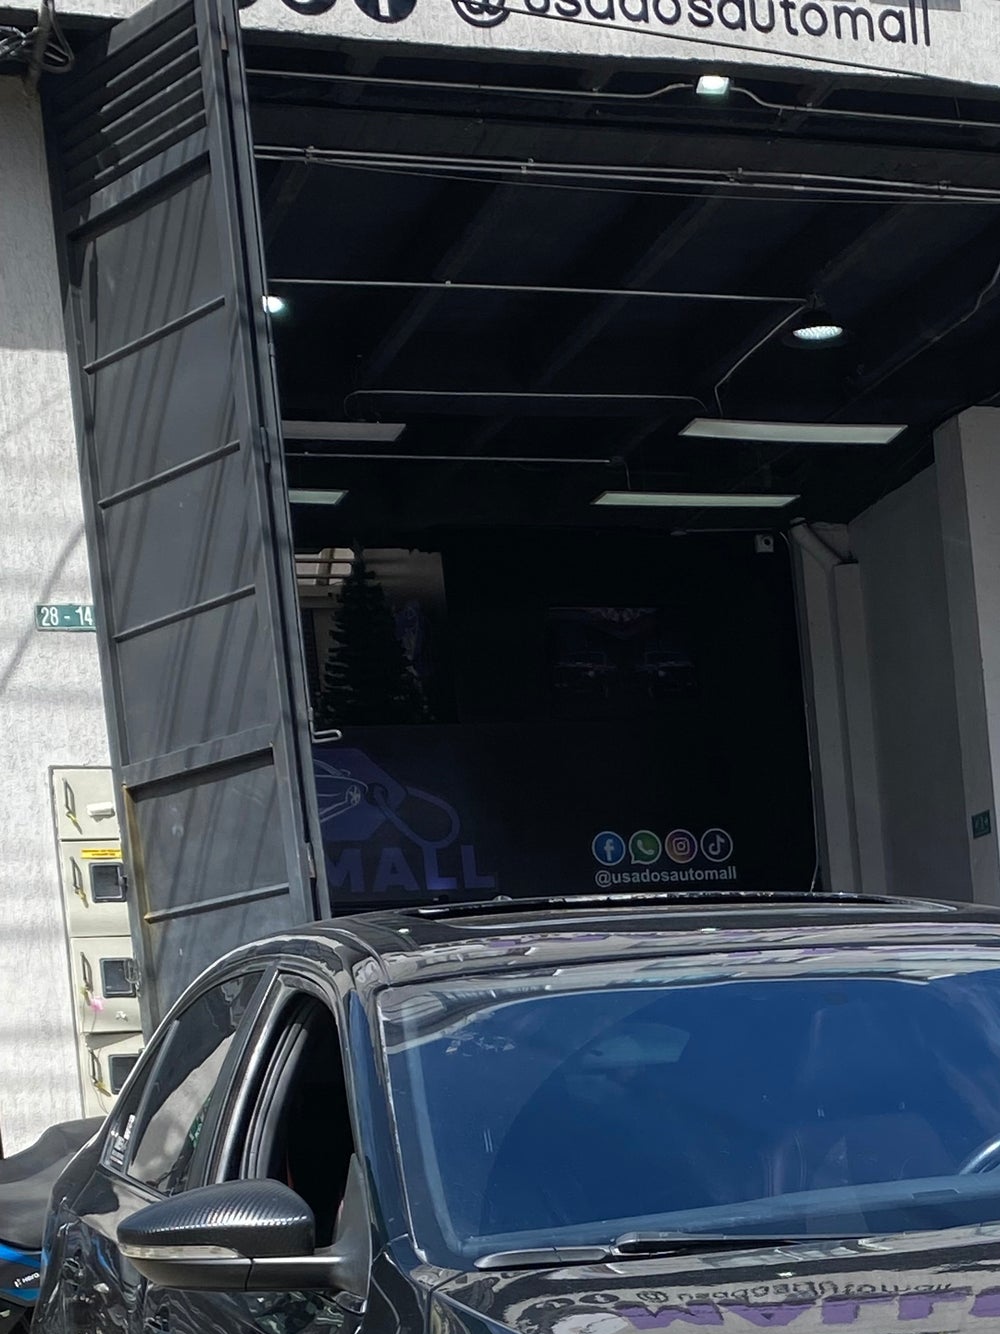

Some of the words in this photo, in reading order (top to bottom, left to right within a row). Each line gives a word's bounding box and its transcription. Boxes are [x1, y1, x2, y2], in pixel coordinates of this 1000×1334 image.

[40, 606, 59, 627] 28
[75, 606, 93, 626] 14
[595, 866, 737, 888] @usadosautomall
